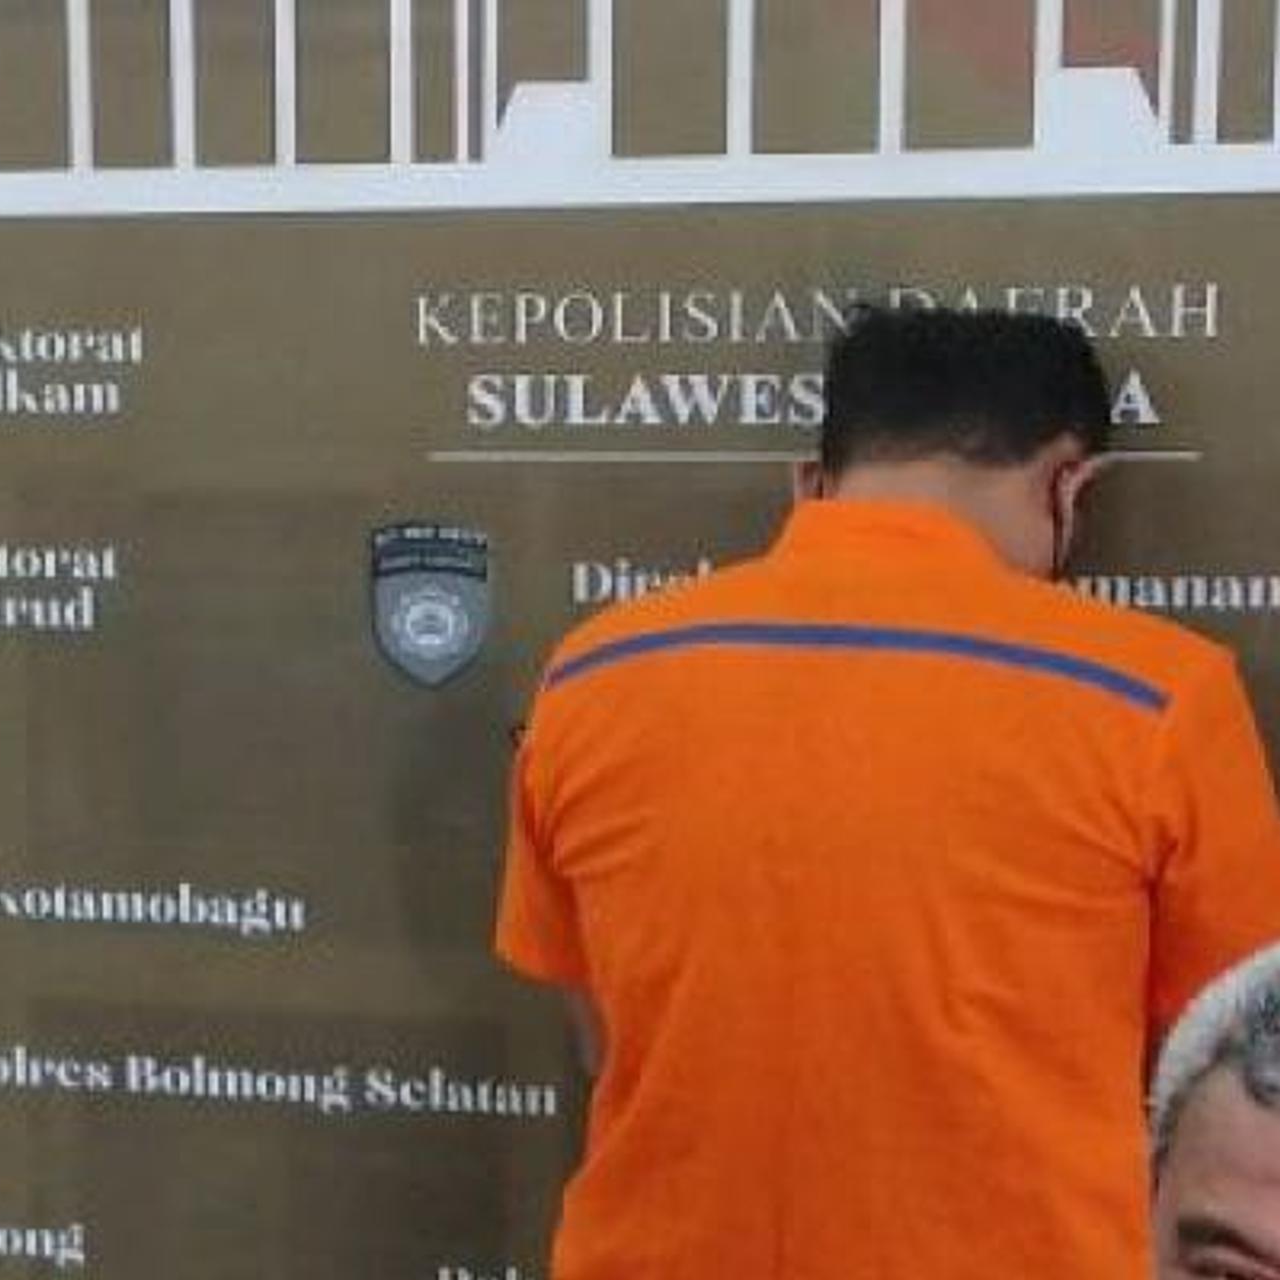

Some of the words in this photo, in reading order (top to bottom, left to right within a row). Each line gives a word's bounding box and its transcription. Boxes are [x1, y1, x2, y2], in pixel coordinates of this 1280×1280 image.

[417, 290, 858, 344] KEPOLISIAN
[466, 373, 825, 427] SULAWES
[125, 1056, 350, 1113] Bolmong
[364, 1068, 557, 1116] Selatan
